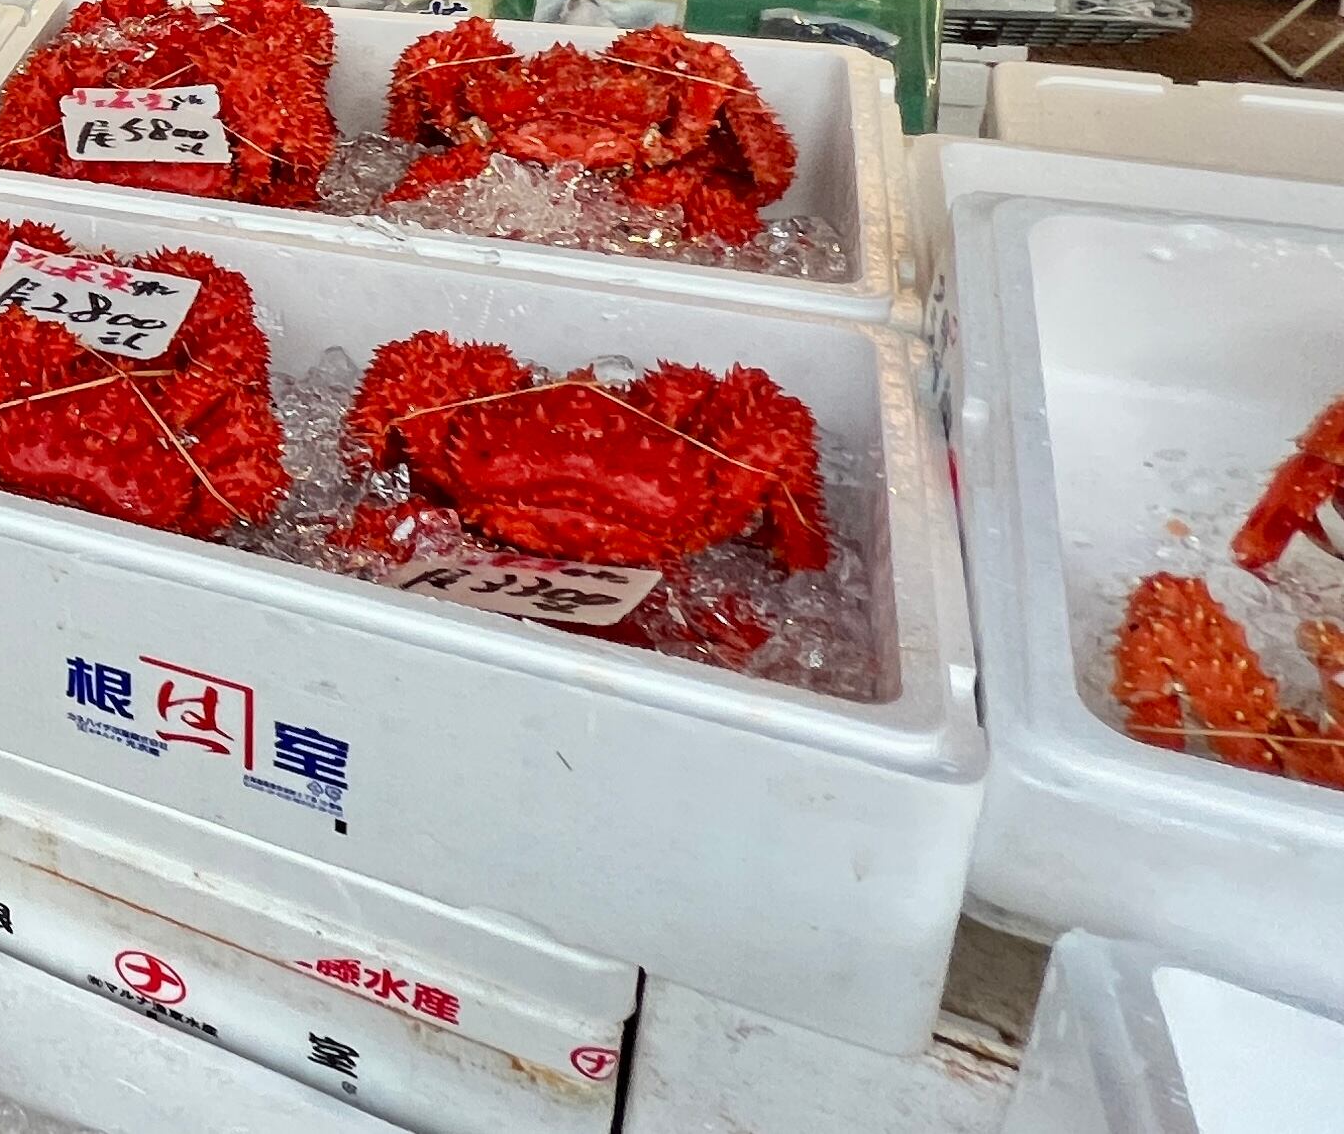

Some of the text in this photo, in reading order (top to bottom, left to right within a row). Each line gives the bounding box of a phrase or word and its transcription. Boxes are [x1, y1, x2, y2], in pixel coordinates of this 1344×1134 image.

[66, 656, 135, 721] 根
[273, 721, 349, 790] 室
[296, 959, 460, 1025] 藤水産
[307, 1031, 360, 1079] 室
